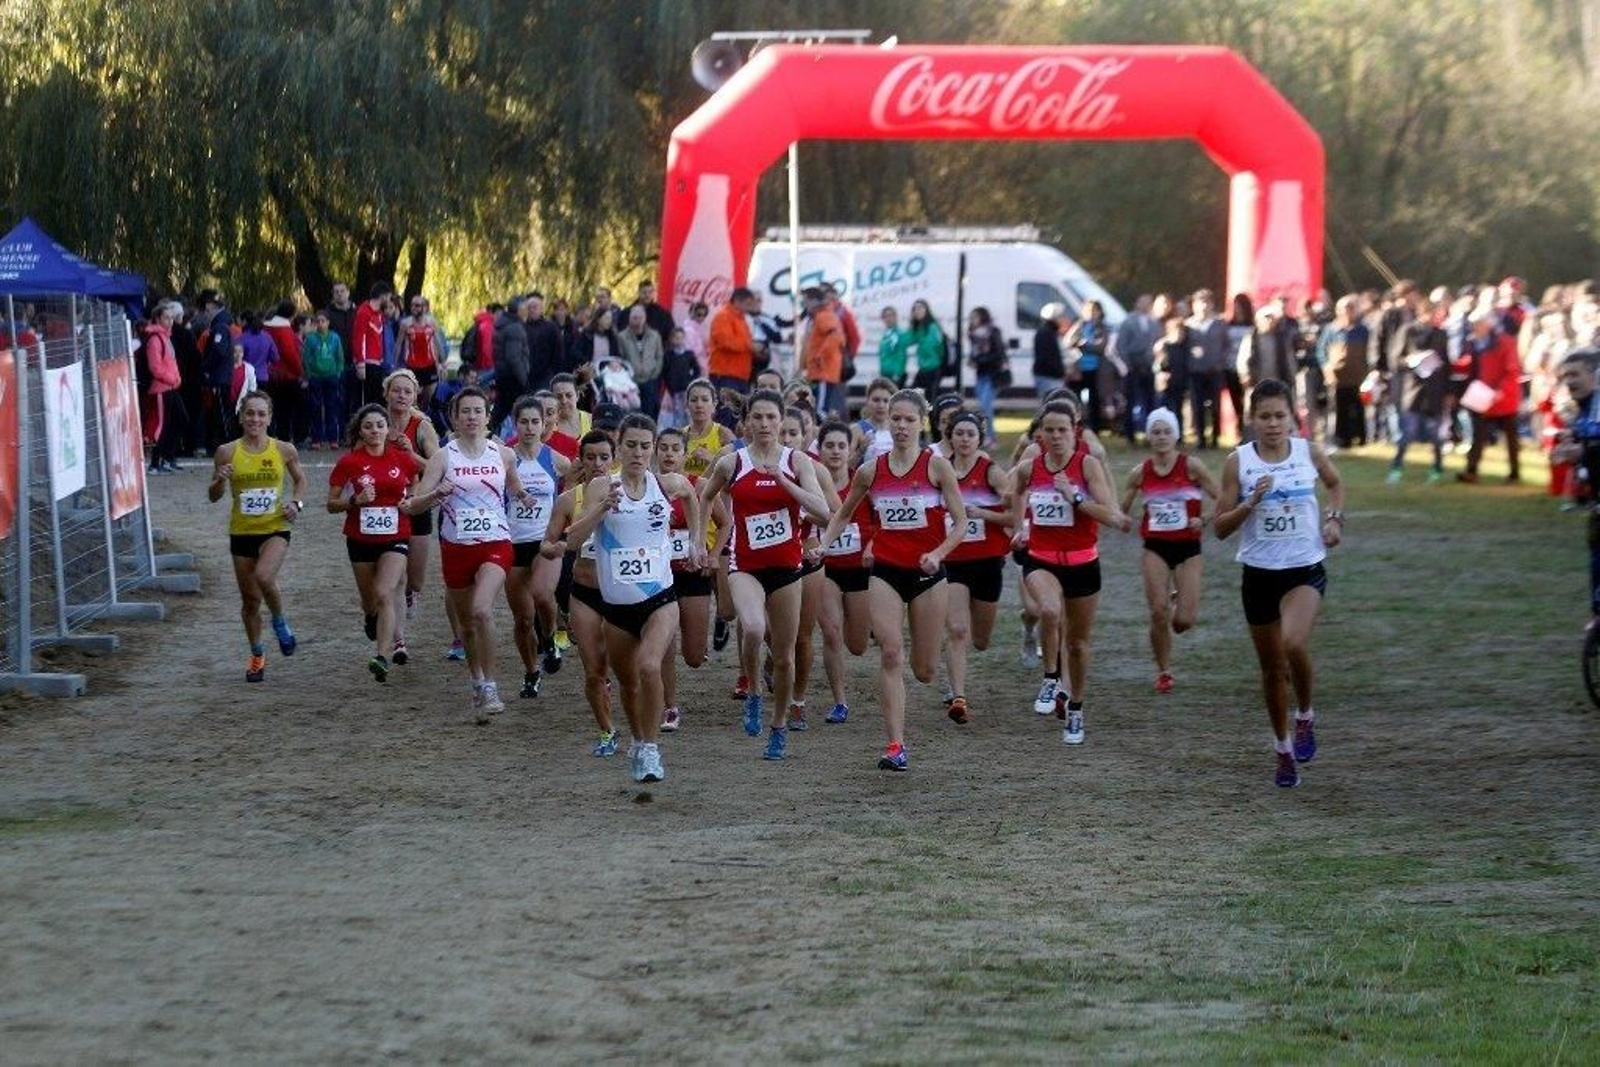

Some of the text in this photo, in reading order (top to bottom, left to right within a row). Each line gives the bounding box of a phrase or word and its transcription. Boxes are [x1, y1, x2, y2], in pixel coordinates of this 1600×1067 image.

[870, 54, 1133, 132] Coca-Cola
[0, 254, 40, 263] RENSE
[454, 466, 499, 476] TREGA
[516, 507, 543, 519] 227
[886, 508, 918, 522] 222
[1036, 504, 1064, 518] 221
[366, 516, 393, 529] 246
[463, 518, 491, 531] 226
[1264, 516, 1296, 532] 501
[755, 521, 785, 541] 233
[619, 559, 651, 575] 231
